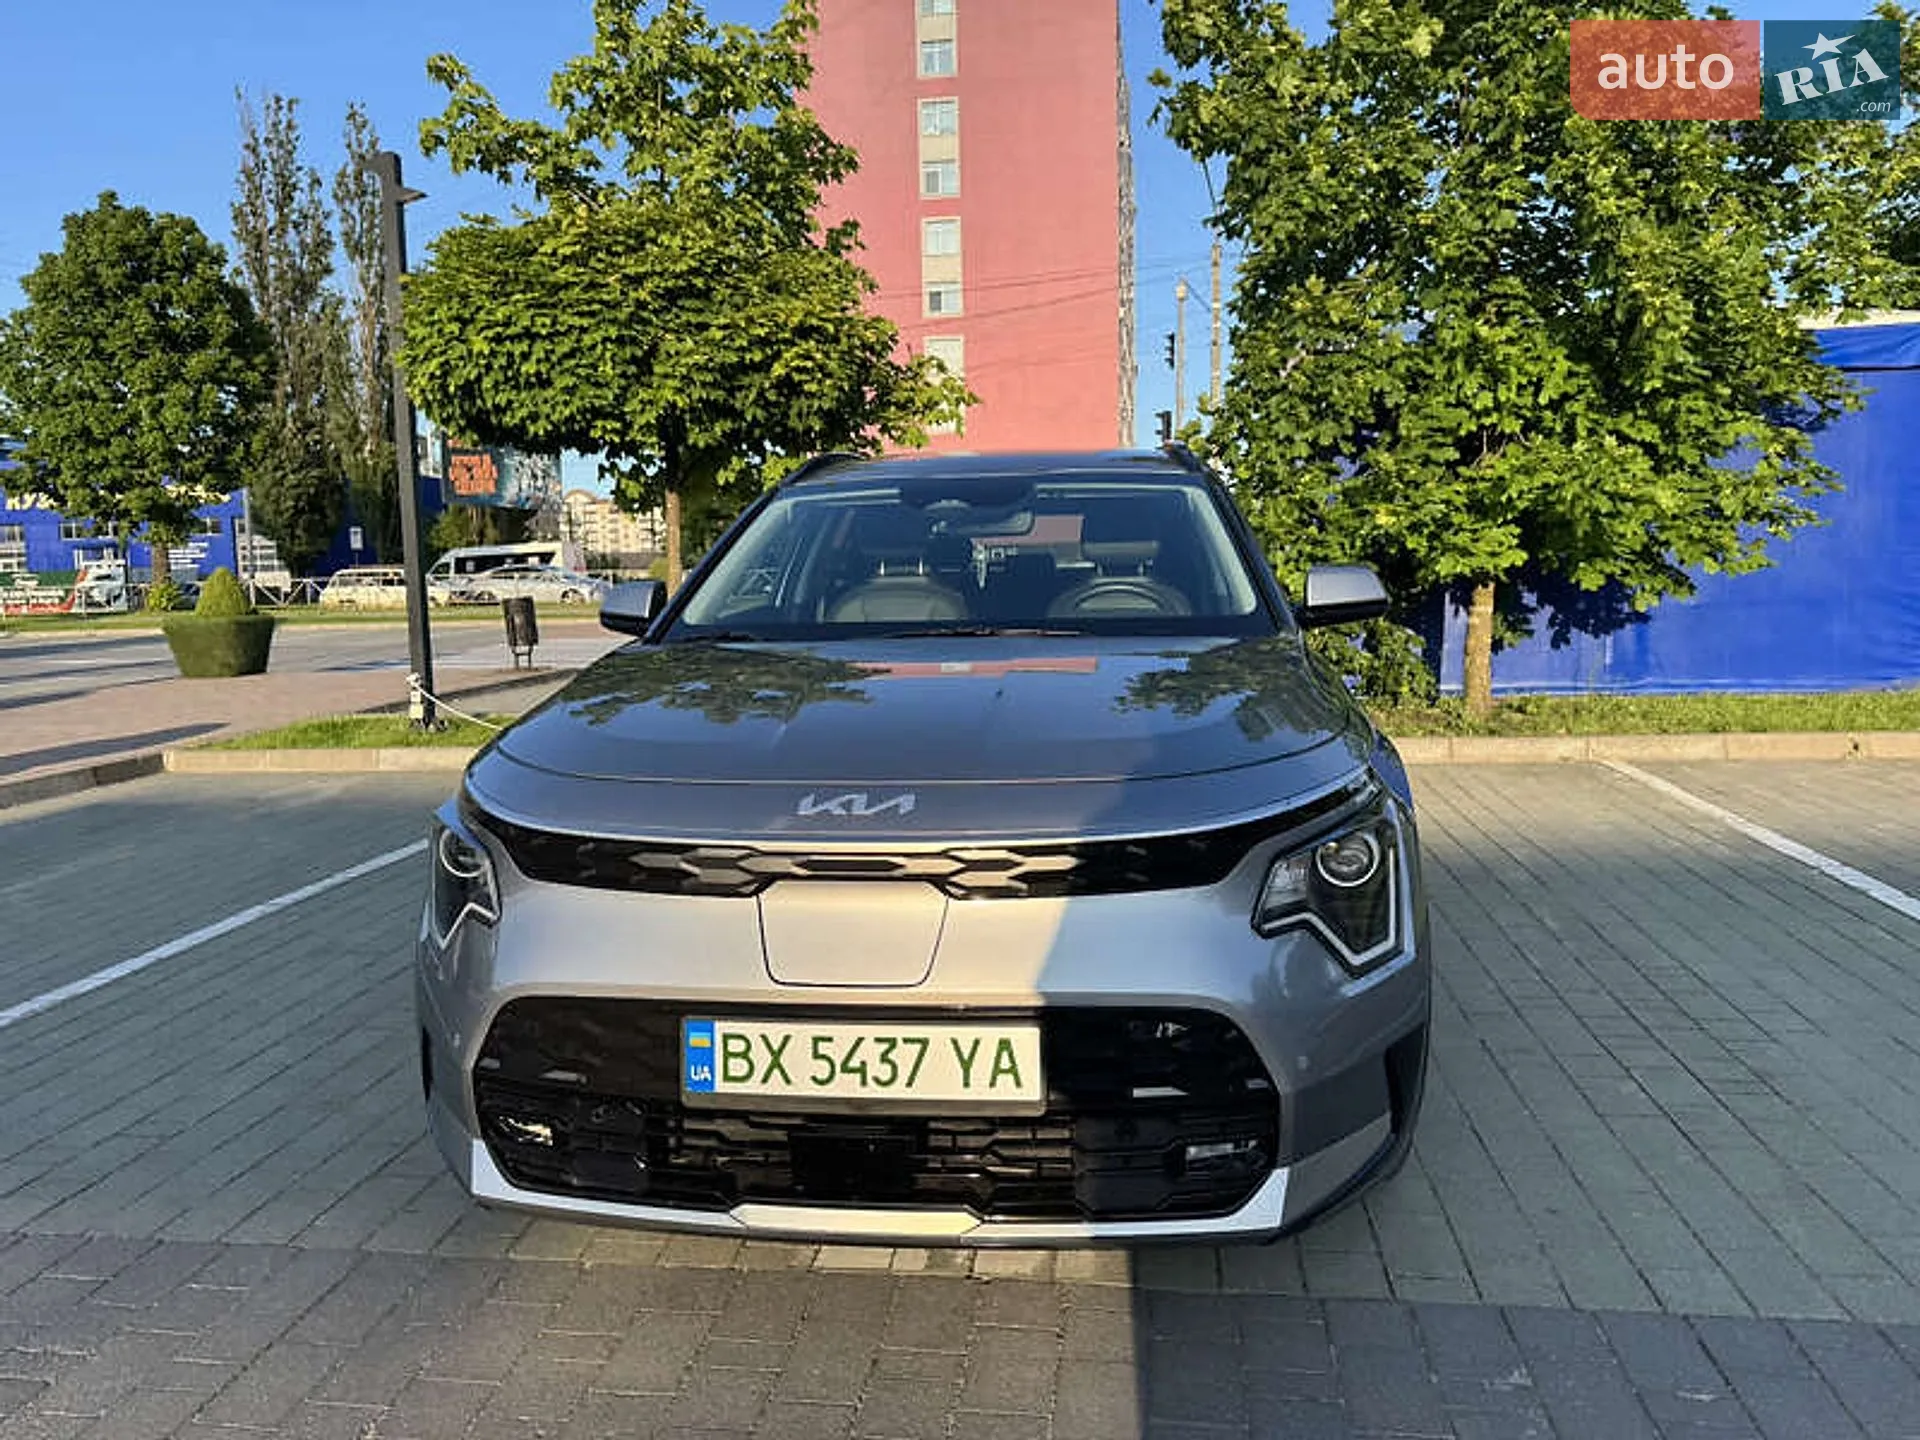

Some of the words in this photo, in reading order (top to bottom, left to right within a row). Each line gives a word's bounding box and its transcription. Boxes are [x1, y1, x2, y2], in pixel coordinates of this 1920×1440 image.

[690, 1065, 712, 1082] UA
[721, 1033, 792, 1085] BX
[810, 1036, 930, 1088] 5437
[950, 1037, 1023, 1088] YA
